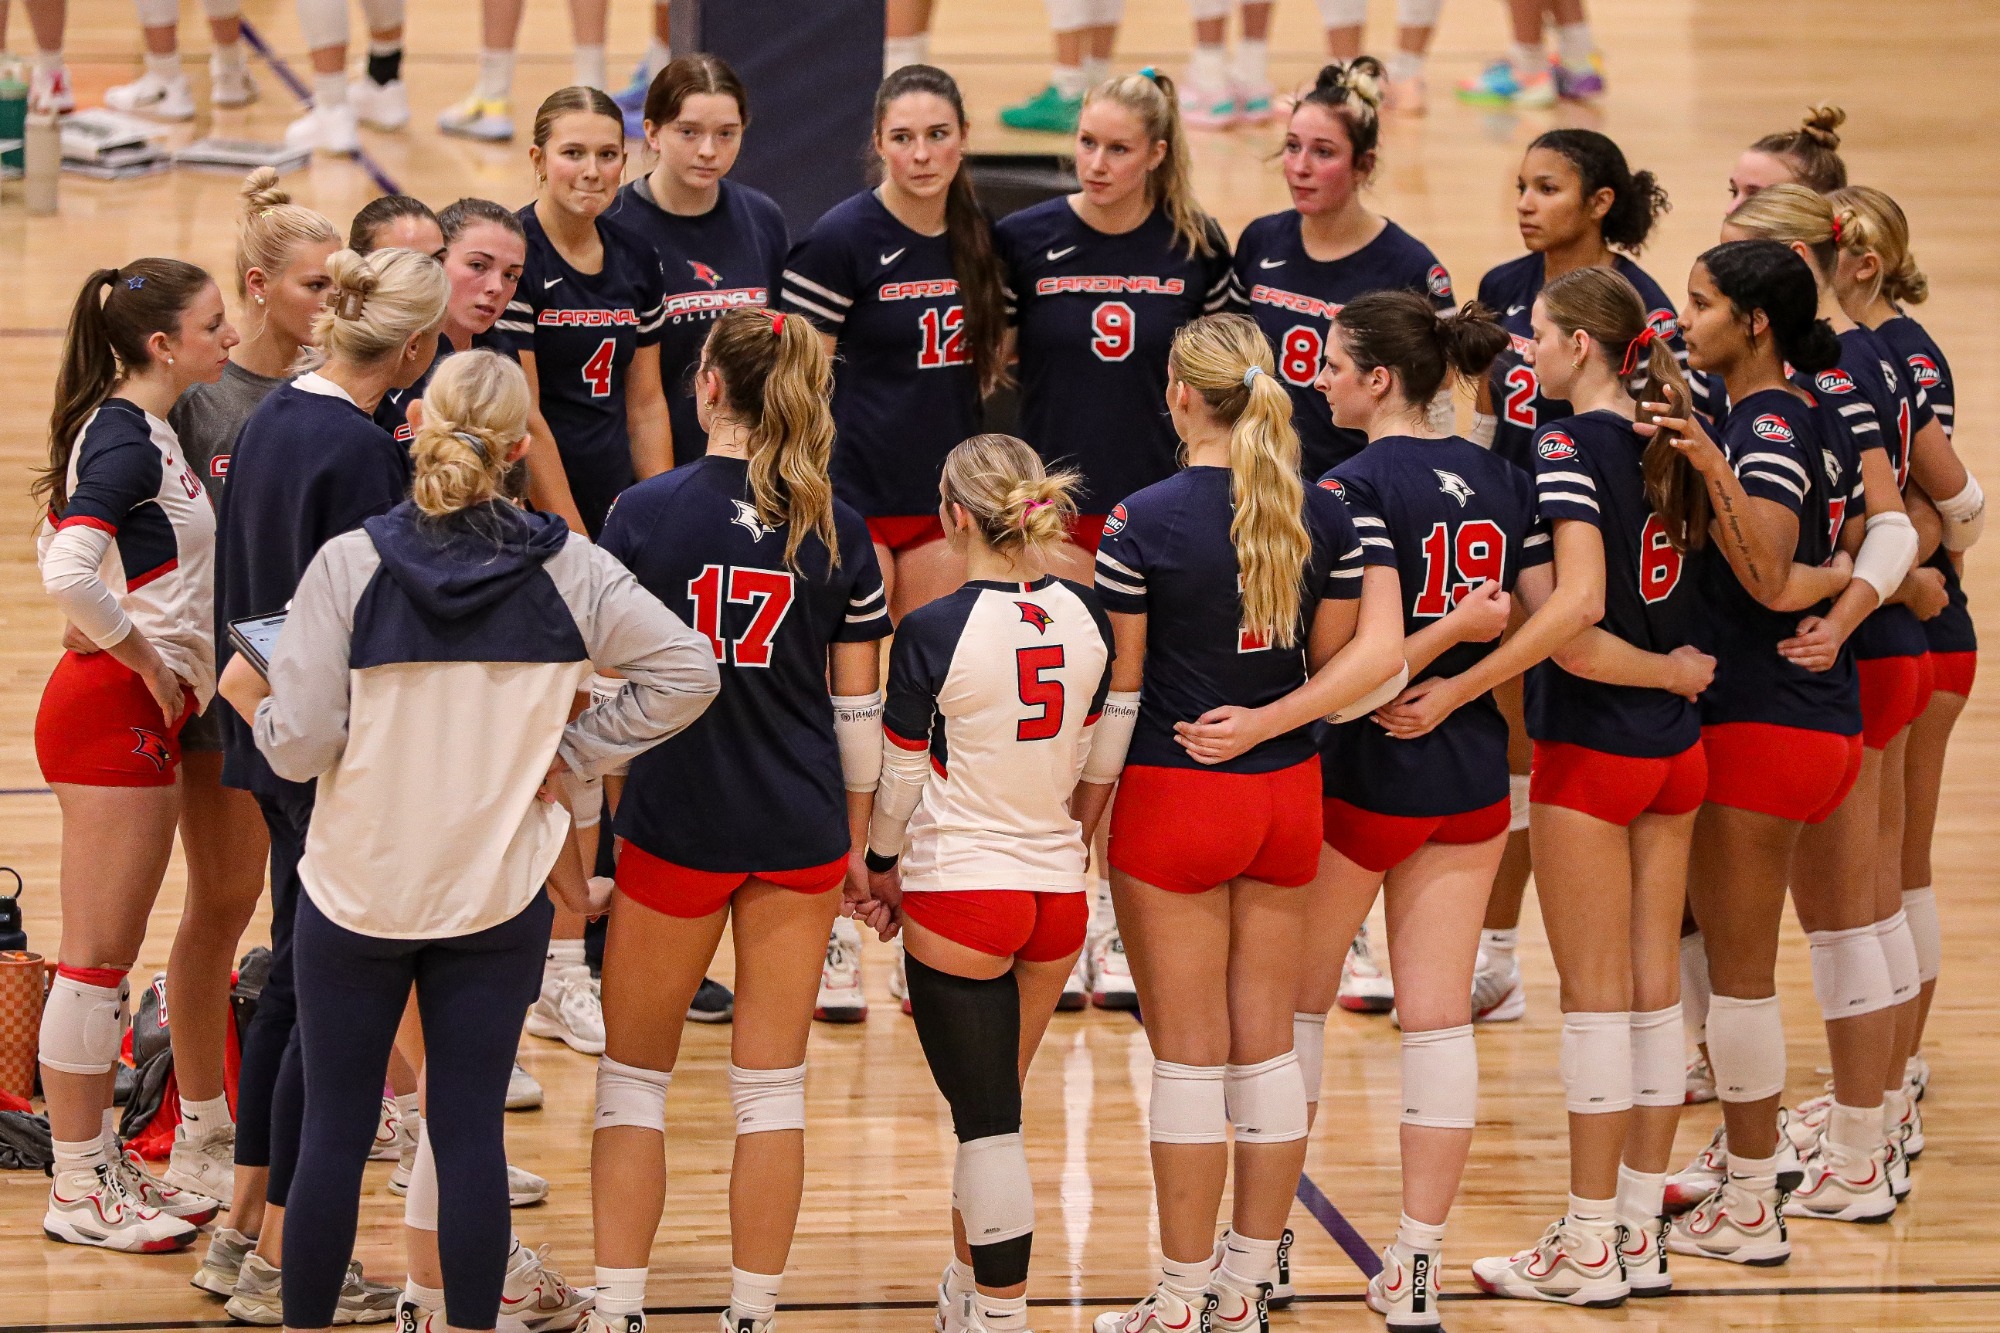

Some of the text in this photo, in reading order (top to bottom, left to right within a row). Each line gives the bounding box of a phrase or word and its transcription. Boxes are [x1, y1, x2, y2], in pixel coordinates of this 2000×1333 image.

[664, 289, 767, 313] ARDINALS
[1036, 275, 1184, 296] CARDINALS
[917, 305, 973, 369] 12
[1092, 301, 1135, 362] 9
[1279, 324, 1323, 388] 8
[581, 337, 616, 398] 4
[1504, 364, 1540, 430] 2
[1541, 441, 1575, 454] GLIAC
[1105, 514, 1123, 530] LIAC
[1412, 519, 1507, 617] 19
[1640, 512, 1686, 604] 6
[687, 564, 795, 668] 17
[1016, 644, 1064, 741] 5
